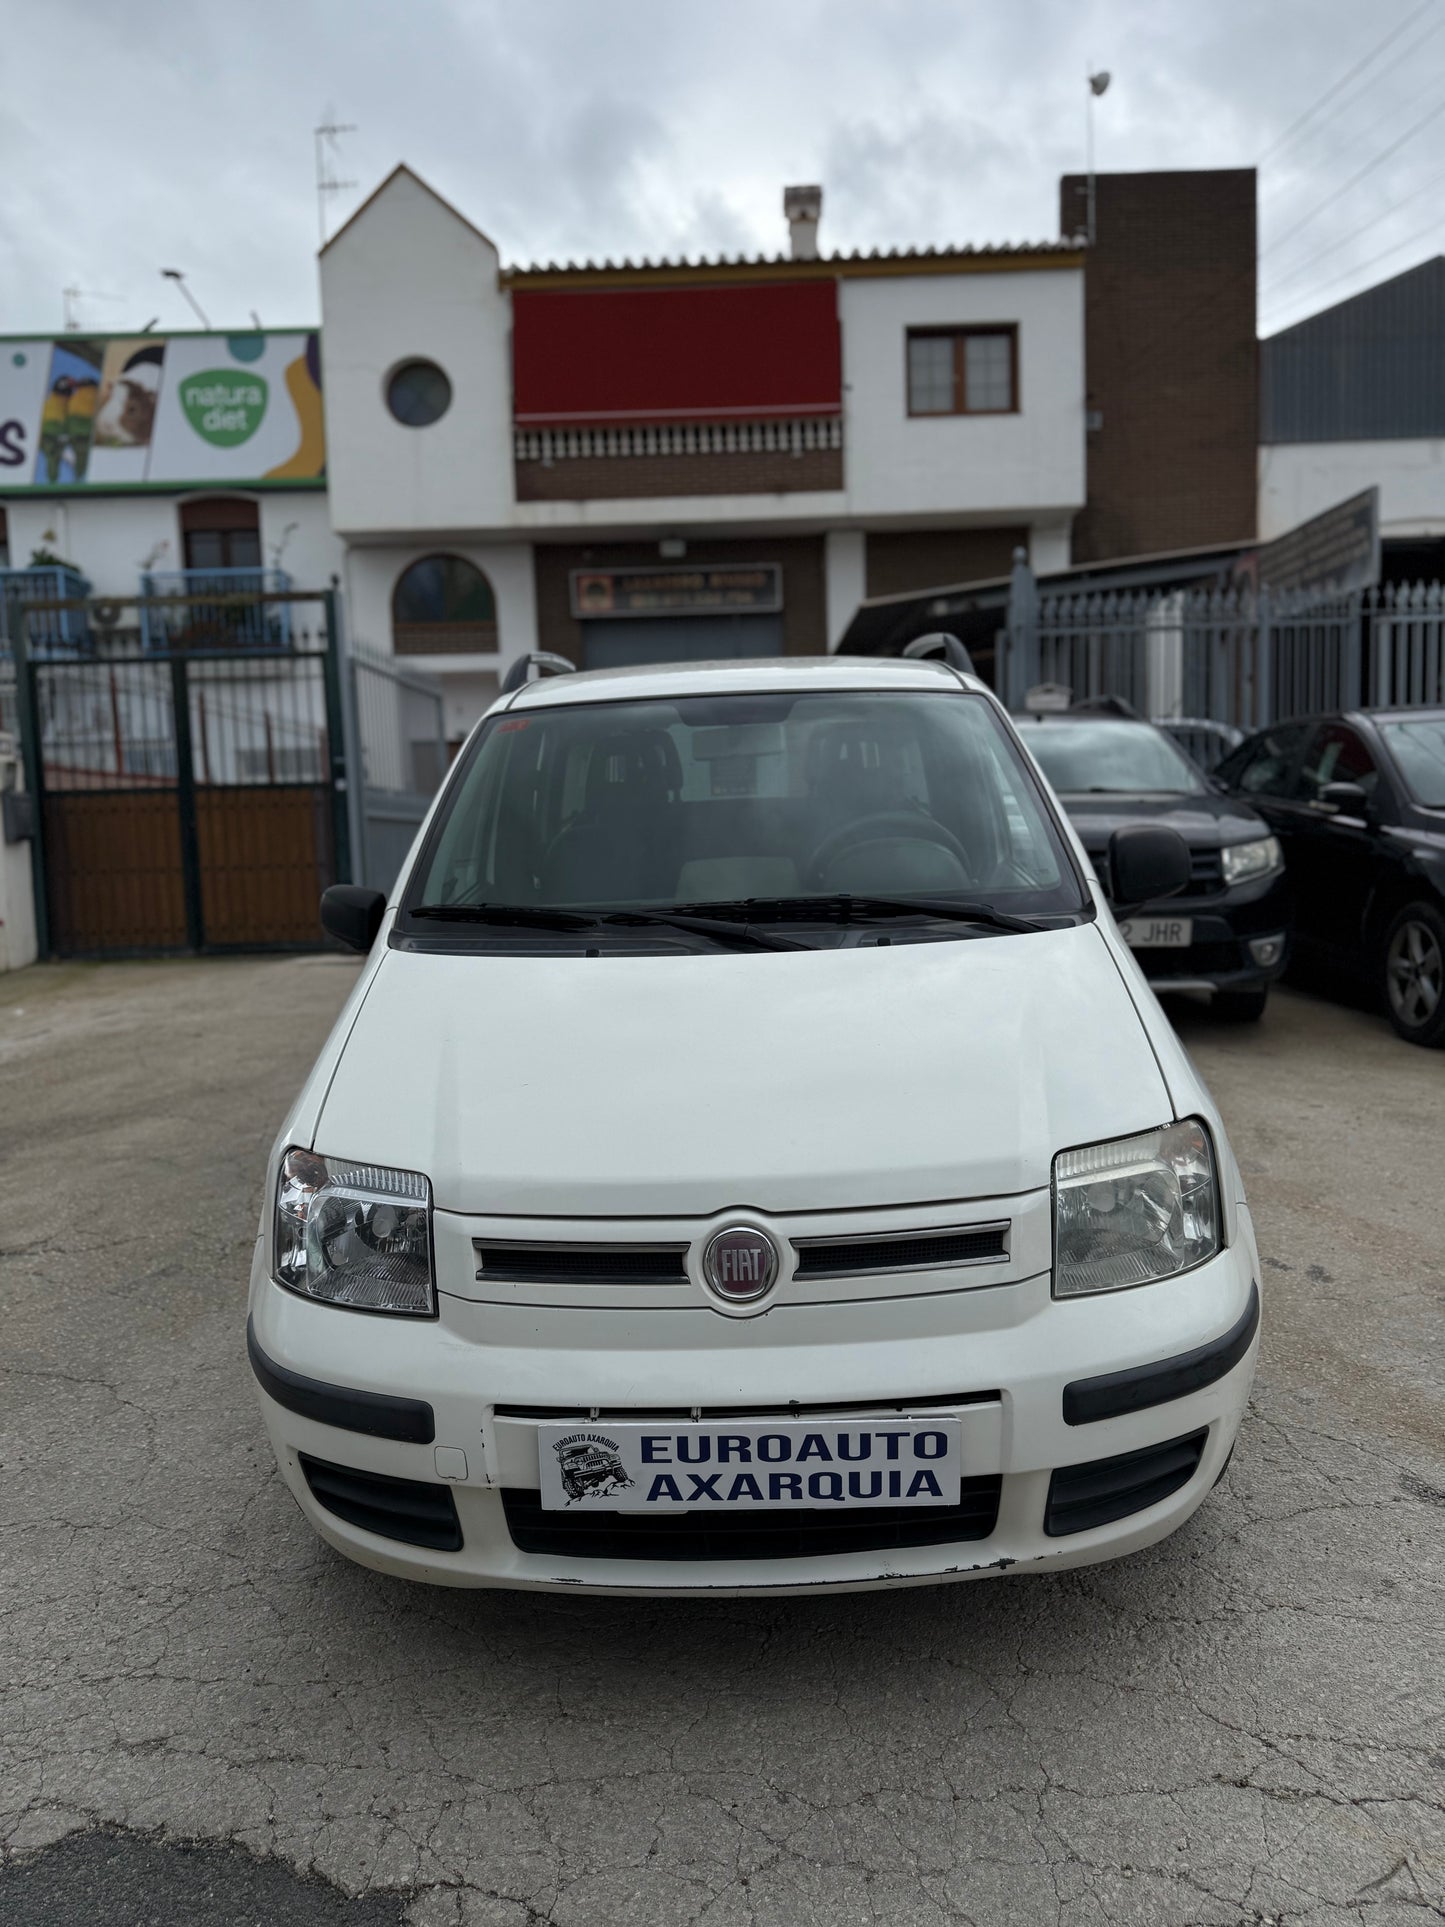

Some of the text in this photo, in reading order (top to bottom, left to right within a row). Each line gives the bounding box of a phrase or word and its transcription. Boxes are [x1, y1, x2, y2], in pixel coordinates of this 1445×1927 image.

[185, 383, 263, 407] natura
[202, 407, 249, 432] diet
[1143, 922, 1182, 942] JHR
[721, 1248, 762, 1282] FIAT
[552, 1433, 620, 1453] EUROAUTO AXARQUIA
[640, 1431, 948, 1464] EUROAUTO
[646, 1469, 943, 1502] AXARQUIA
